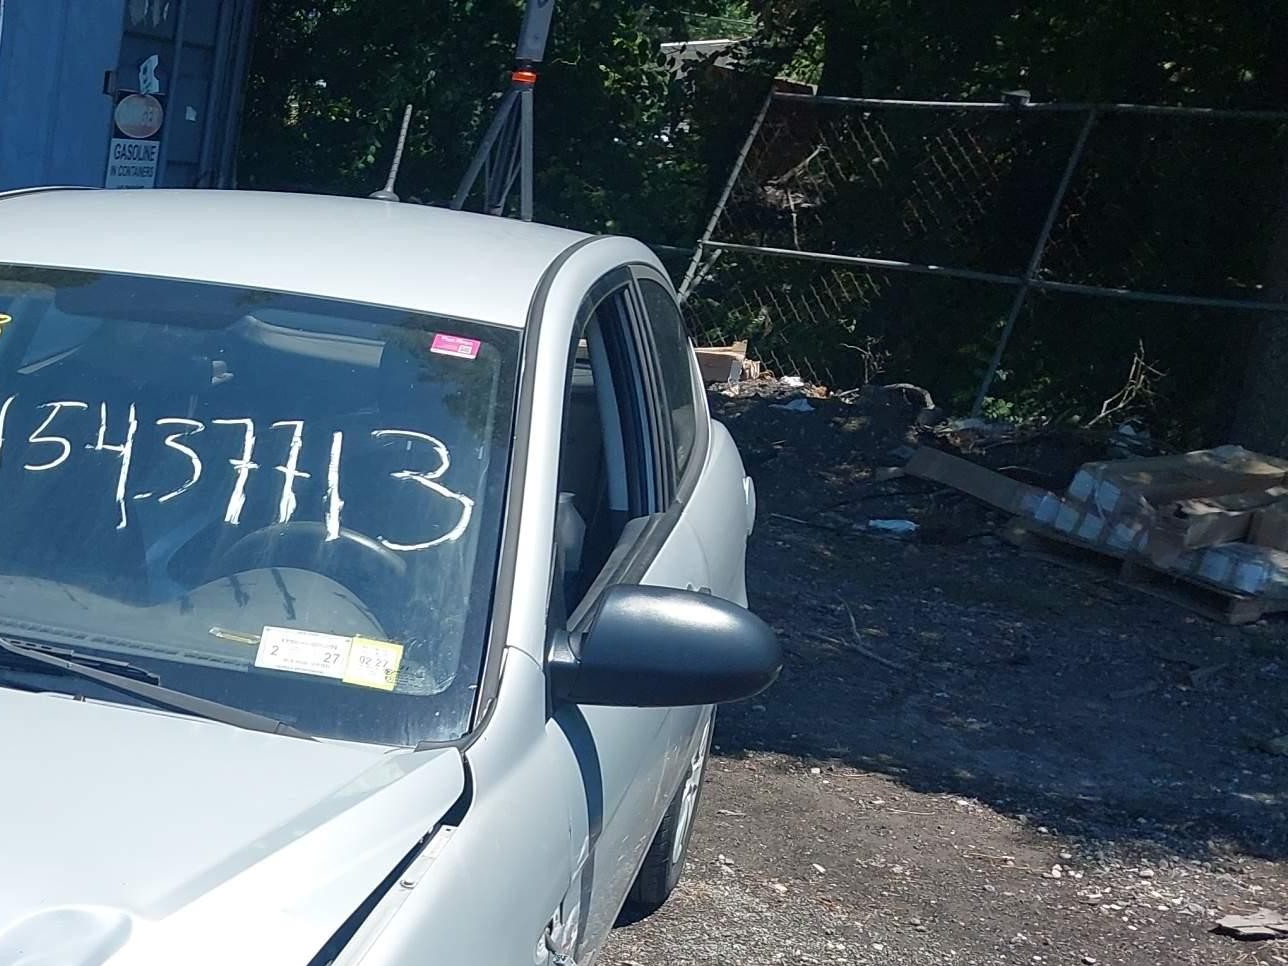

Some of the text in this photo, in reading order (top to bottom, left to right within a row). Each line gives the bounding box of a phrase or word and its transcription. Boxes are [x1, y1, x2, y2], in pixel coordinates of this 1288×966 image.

[114, 143, 156, 161] GASOLINE
[270, 645, 280, 656] 2
[323, 652, 340, 664] 27
